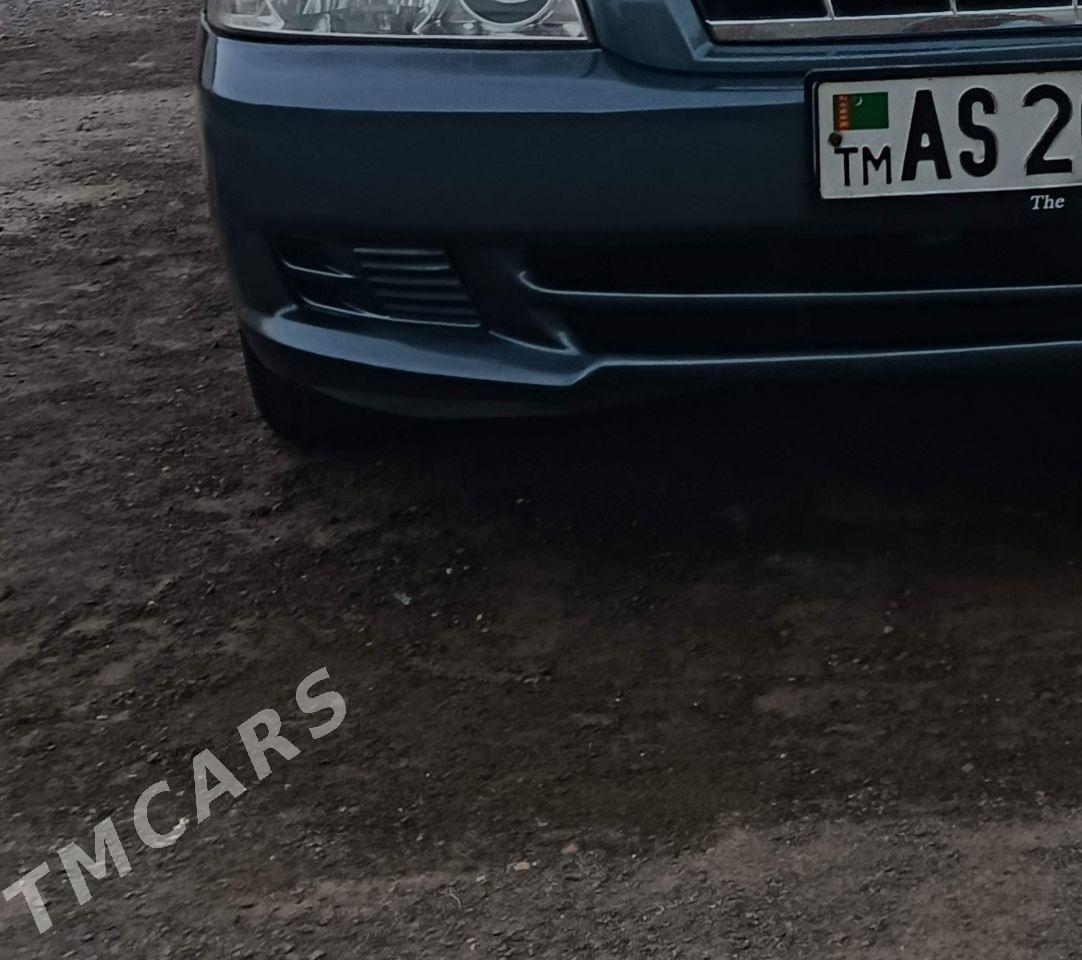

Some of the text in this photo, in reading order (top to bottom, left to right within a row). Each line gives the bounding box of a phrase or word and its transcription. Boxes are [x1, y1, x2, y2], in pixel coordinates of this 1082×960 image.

[901, 87, 998, 181] AS
[834, 145, 892, 186] TM
[1030, 194, 1065, 211] The
